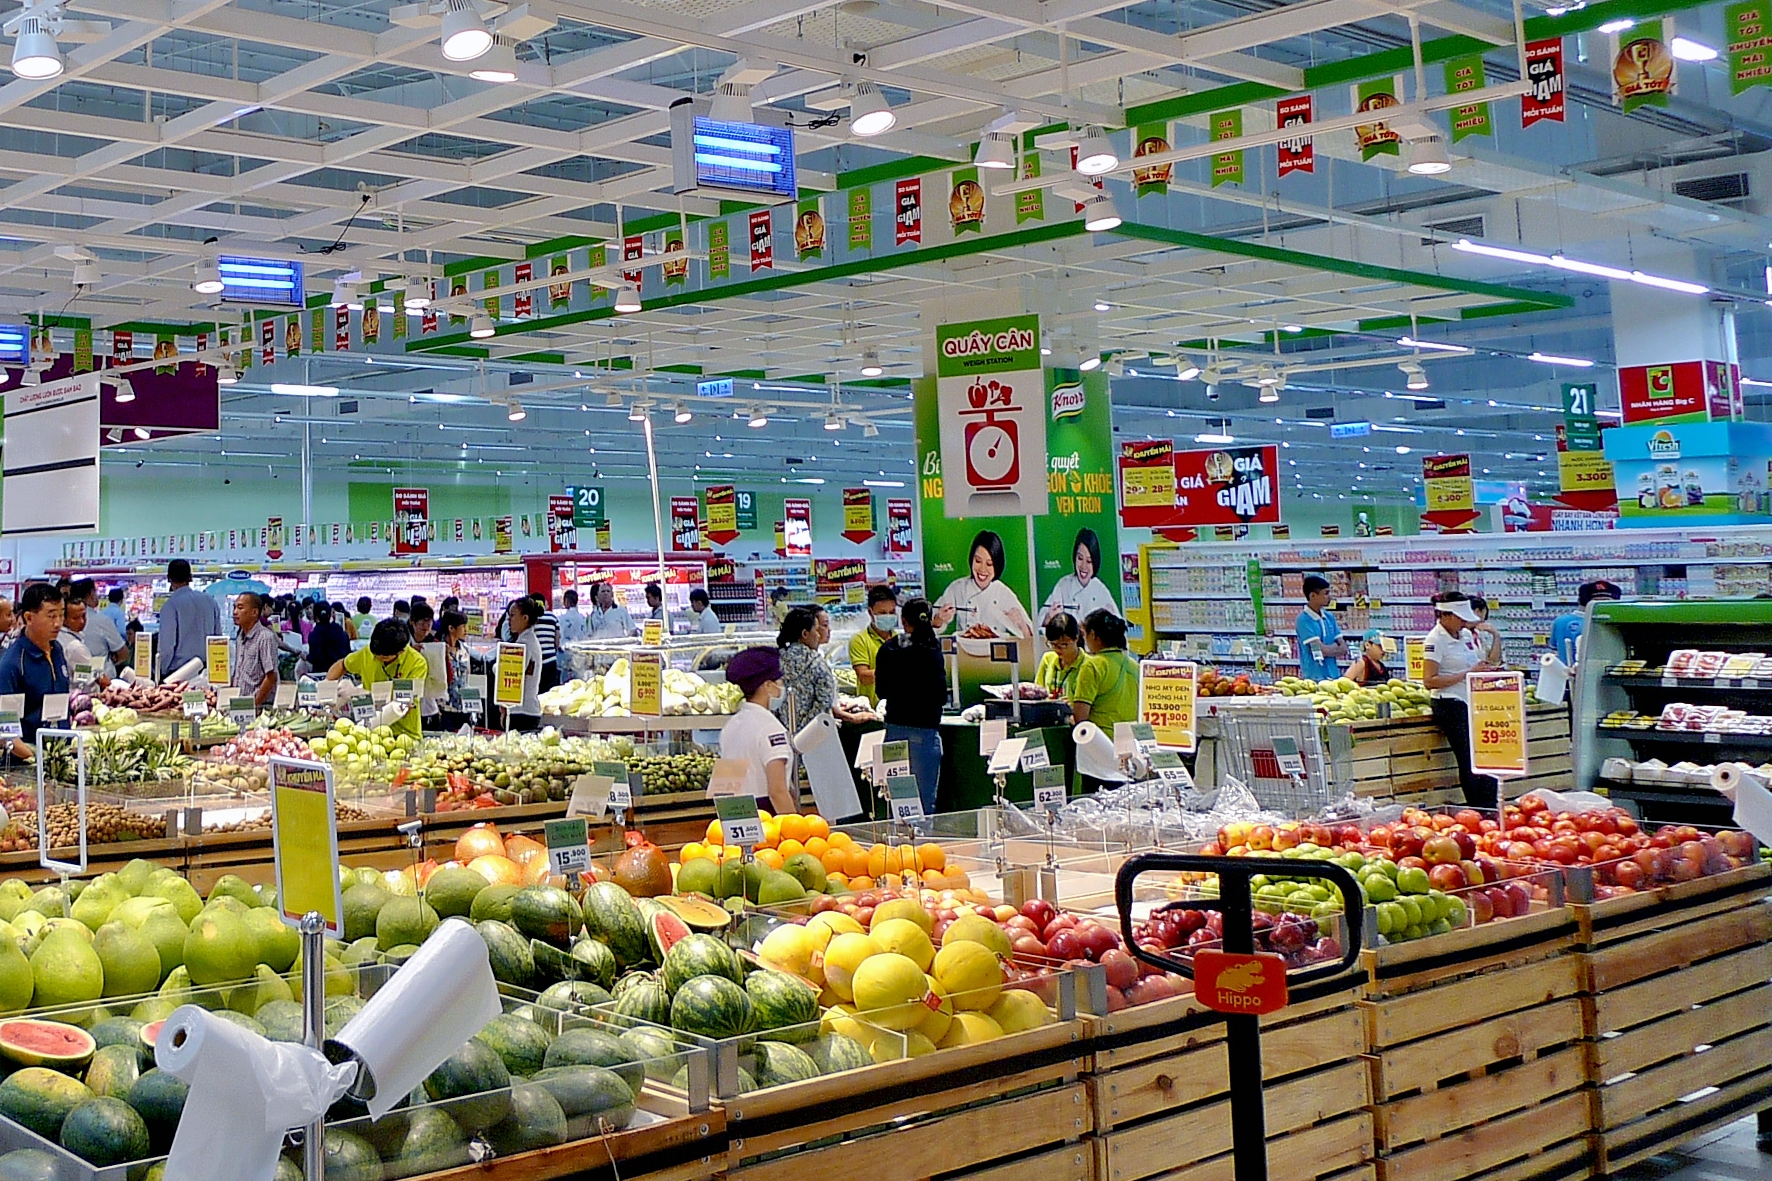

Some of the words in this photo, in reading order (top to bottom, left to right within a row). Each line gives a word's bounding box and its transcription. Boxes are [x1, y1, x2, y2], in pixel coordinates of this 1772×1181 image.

[1529, 60, 1554, 75] GIÁ
[901, 195, 916, 205] GIÁ
[944, 332, 991, 355] QUẦY
[996, 330, 1032, 350] CÂN
[963, 359, 985, 367] WEIGH
[986, 356, 1014, 365] STATION
[1053, 391, 1085, 411] Knorr
[1570, 387, 1588, 415] 21
[1051, 451, 1080, 475] quyết
[1234, 454, 1263, 471] GIÁ
[1181, 474, 1204, 488] GIÁ
[1576, 473, 1607, 482] 3.300
[579, 489, 599, 506] 20
[737, 493, 751, 509] 19
[1217, 475, 1271, 516] GIẢM
[1217, 991, 1261, 1008] Hippo
